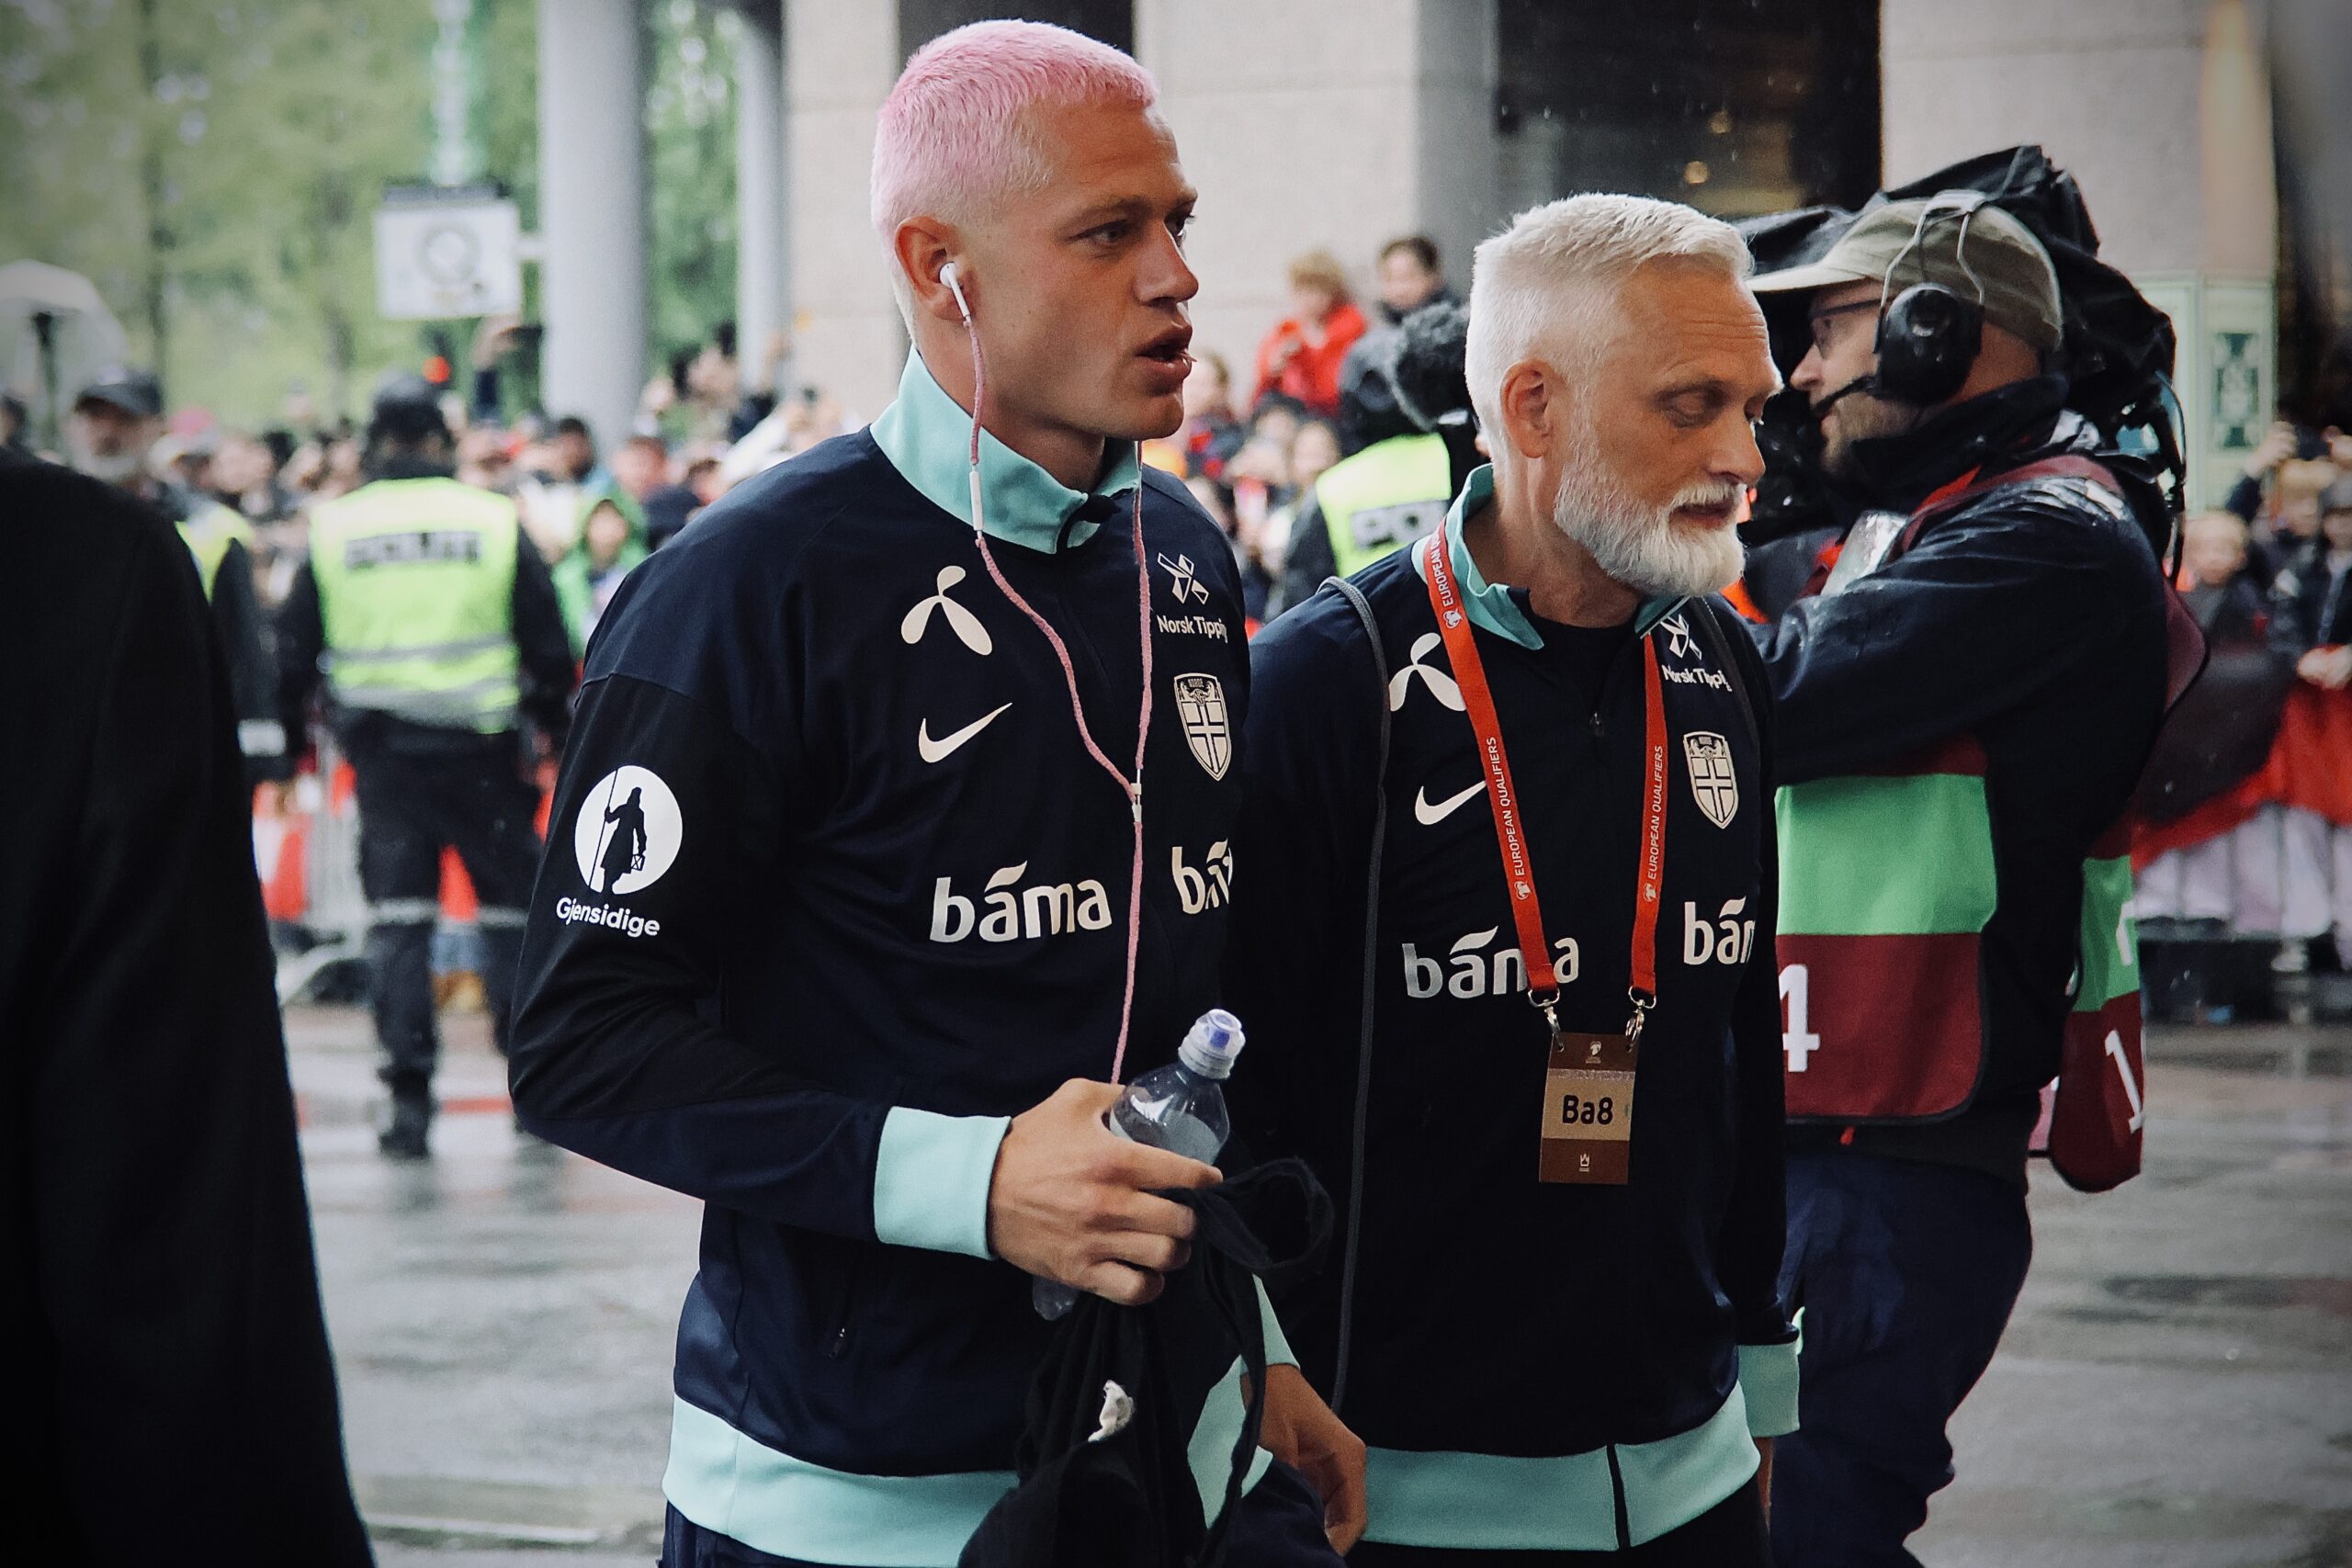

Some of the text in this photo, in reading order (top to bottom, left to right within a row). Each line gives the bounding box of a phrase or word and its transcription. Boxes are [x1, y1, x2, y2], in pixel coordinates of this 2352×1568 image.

[1157, 615, 1195, 634] Norsk
[1487, 737, 1525, 876] EUROPEAN QUALIFIERS
[1647, 745, 1664, 880] EUROPEAN QUALIFIERS
[556, 897, 661, 938] Gjensidige
[1562, 1094, 1613, 1125] Ba8
